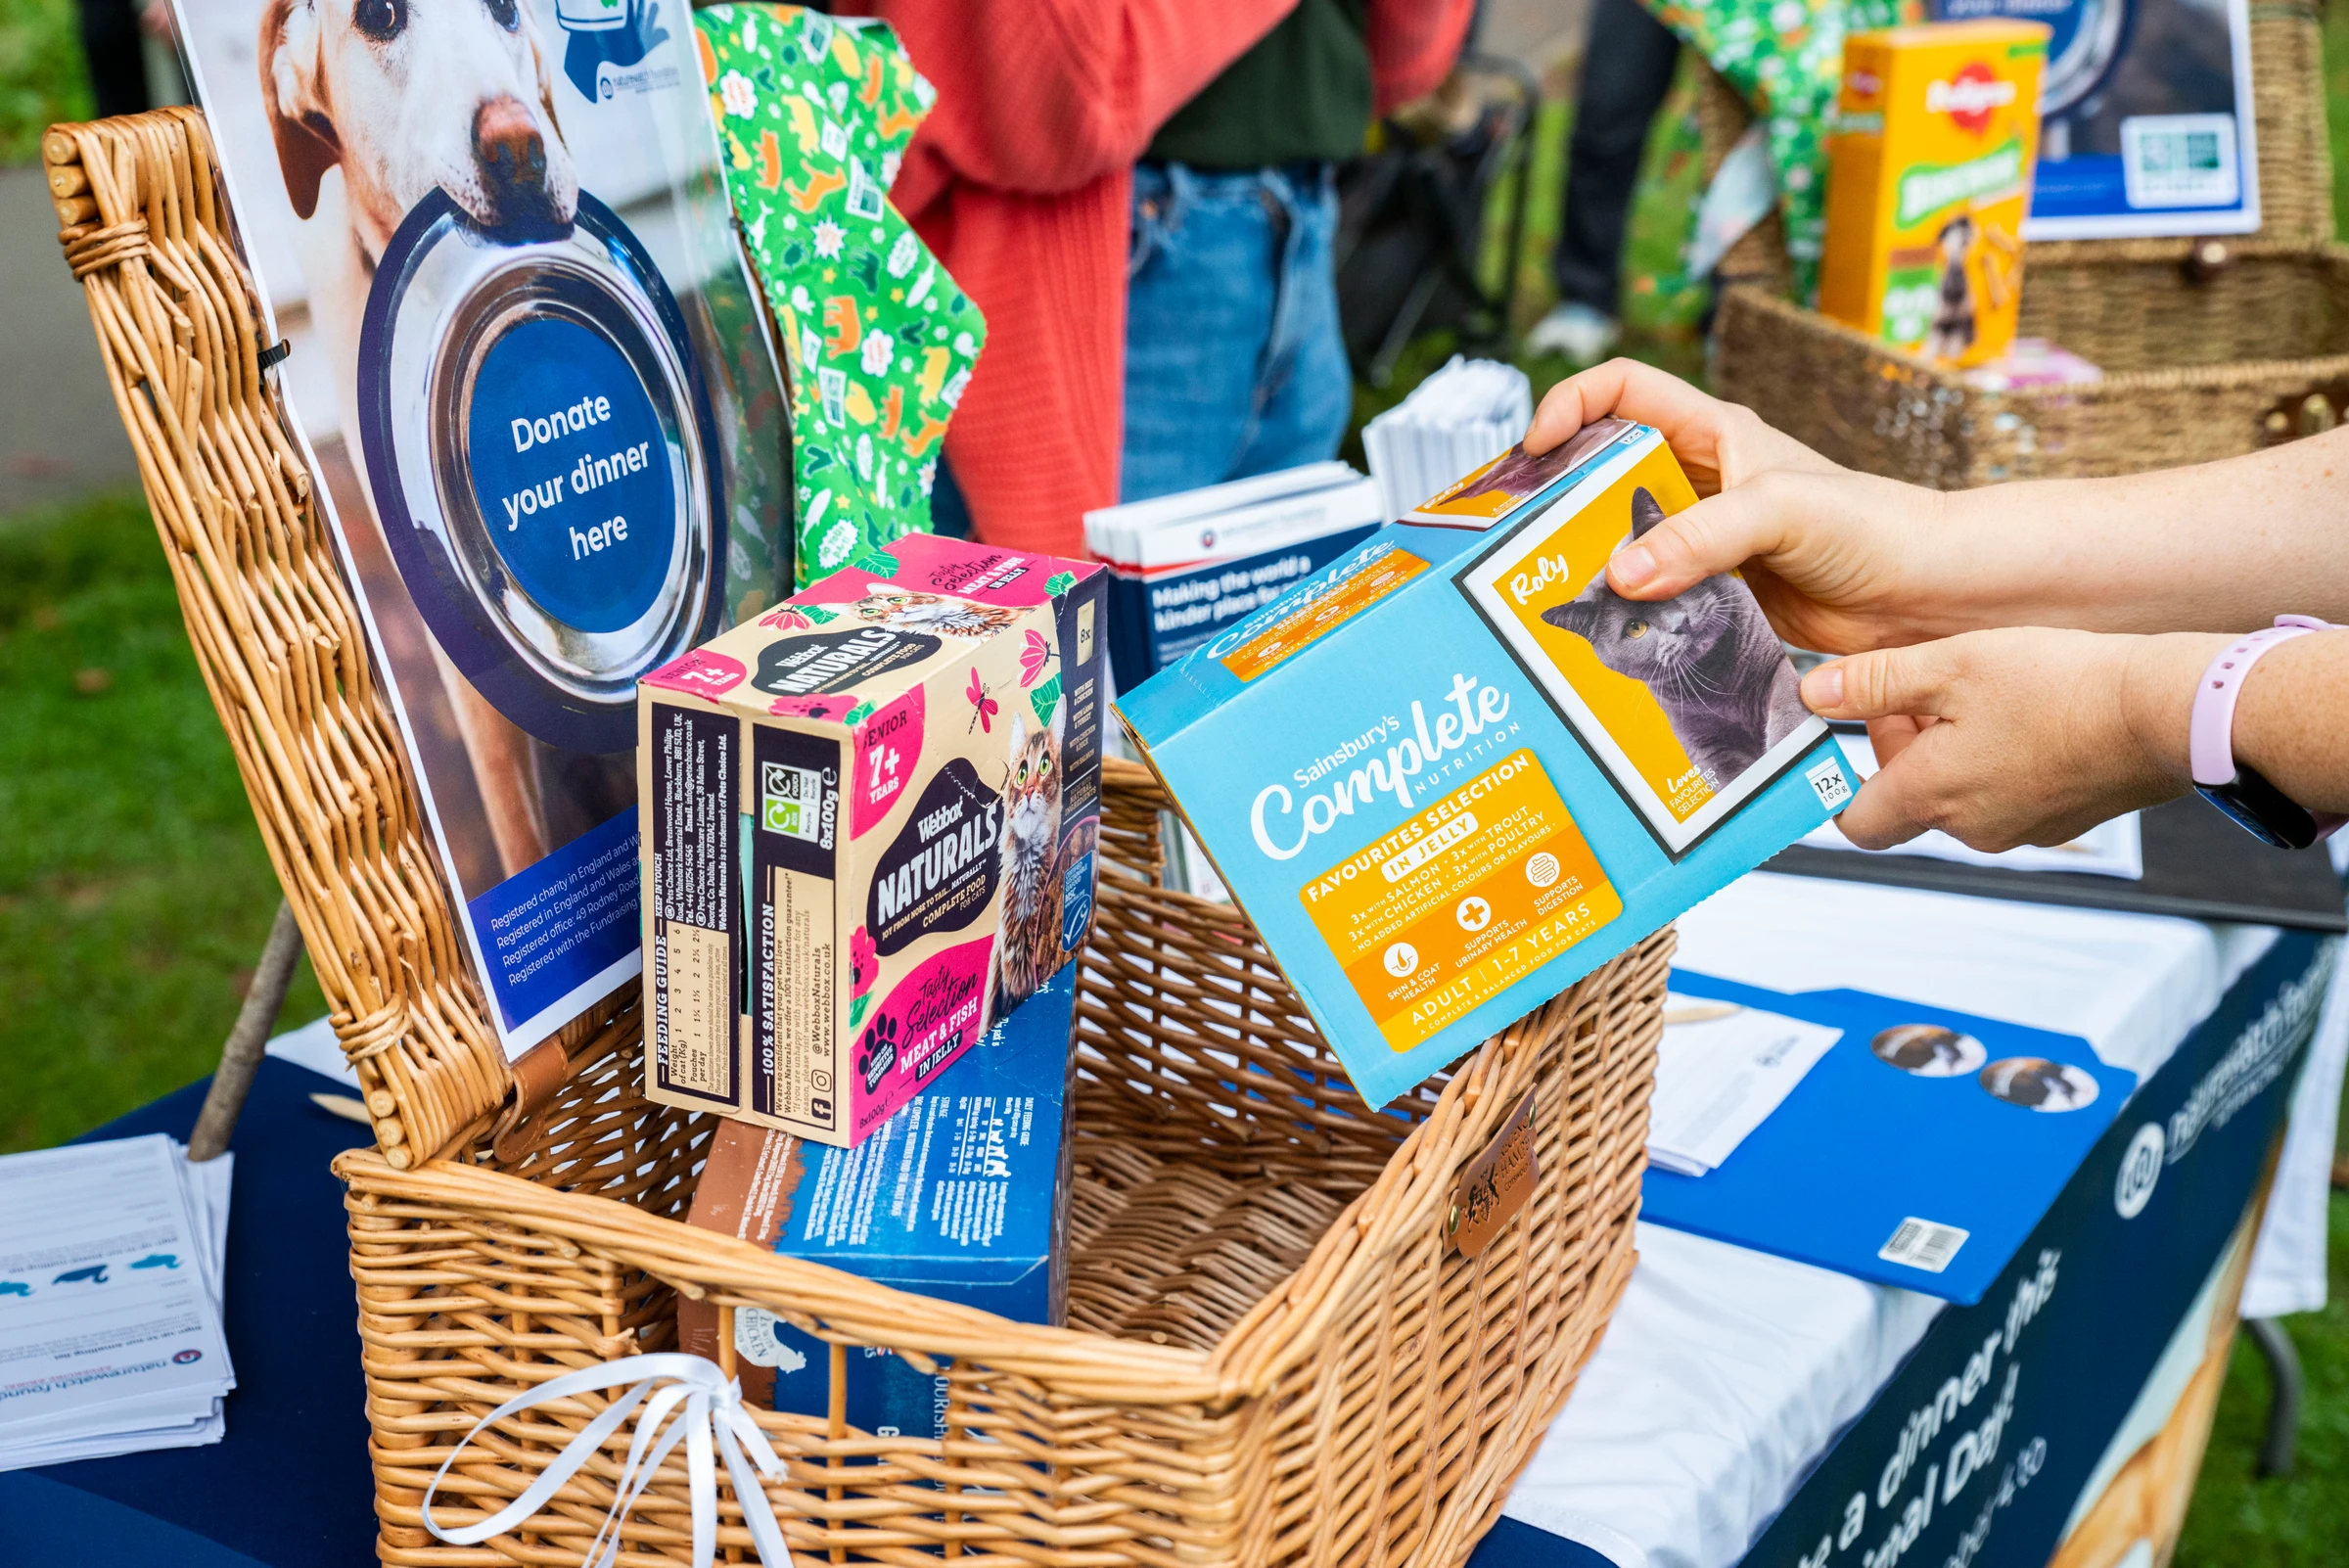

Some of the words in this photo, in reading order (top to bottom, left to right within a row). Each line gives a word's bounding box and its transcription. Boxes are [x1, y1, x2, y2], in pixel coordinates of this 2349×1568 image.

[510, 395, 611, 453] Donate
[501, 475, 564, 531] your
[570, 440, 649, 495] dinner
[568, 515, 628, 561] here
[1152, 577, 1221, 609] Making
[1221, 569, 1250, 593] the
[1251, 558, 1298, 585] world
[1298, 556, 1312, 574] a
[1206, 540, 1396, 660] Complete
[1509, 552, 1570, 607] Roly
[1154, 604, 1212, 634] kinder
[1214, 591, 1257, 623] place
[1244, 579, 1321, 630] Sainsbury's
[775, 643, 829, 668] Webbox
[1081, 627, 1091, 644] 8x
[767, 628, 897, 694] NATURALS
[869, 744, 900, 789] 7+
[1251, 673, 1510, 861] Complete
[1294, 713, 1402, 789] Sainsbury's
[1414, 720, 1521, 795] NUTRITION
[869, 775, 900, 805] YEARS
[1666, 763, 1701, 795] Loves
[1669, 767, 1717, 809] FAVOURITES
[1678, 777, 1721, 816] SELECTION
[1815, 773, 1843, 795] 12x
[1822, 785, 1848, 803] 100g
[819, 789, 840, 851] 8x100g
[918, 800, 963, 844] Webbox
[1307, 821, 1423, 902] FAVOURITES
[1425, 754, 1529, 828] SELECTION
[654, 852, 663, 884] TOUCH
[878, 803, 997, 927] NATURALS
[1351, 912, 1367, 925] 3x
[1366, 898, 1386, 912] WITH
[1386, 863, 1441, 902] SALMON
[1451, 848, 1467, 861] 3x
[1466, 836, 1486, 850] WITH
[1486, 806, 1529, 840] TROUT
[1388, 857, 1412, 879] IN
[1416, 817, 1473, 861] JELLY
[490, 893, 538, 932] Registered
[538, 877, 568, 902] charity
[567, 872, 578, 884] in
[576, 849, 613, 879] England
[613, 839, 629, 857] and
[654, 883, 663, 895] IN
[959, 896, 971, 910] FOR
[971, 885, 986, 901] CATS
[1348, 928, 1364, 942] 3x
[1364, 915, 1385, 930] WITH
[1385, 877, 1443, 919] CHICKEN
[1452, 862, 1469, 876] 3x
[1468, 850, 1488, 863] WITH
[1488, 810, 1544, 853] POULTRY
[1357, 939, 1371, 951] NO
[1373, 919, 1403, 942] ADDED
[1405, 890, 1451, 922] ARTIFICIAL
[1451, 861, 1493, 892] COLOURS
[1493, 853, 1506, 865] OR
[1506, 824, 1551, 856] FLAVOURS
[1533, 875, 1578, 907] SUPPORTS
[495, 911, 544, 949] Registered
[542, 908, 554, 921] in
[552, 883, 589, 914] England
[589, 873, 606, 893] and
[605, 860, 631, 881] Wales
[654, 894, 663, 918] KEEP
[881, 925, 893, 941] JOY
[893, 912, 910, 932] FROM
[910, 901, 926, 920] NOSE
[925, 896, 935, 908] TO
[922, 889, 965, 928] COMPLETE
[965, 874, 986, 897] FOOD
[1537, 882, 1584, 916] DIGESTION
[501, 929, 550, 968] Registered
[550, 916, 576, 940] office:
[576, 908, 587, 922] 49
[587, 887, 619, 918] Rodney
[507, 947, 555, 987] Registered
[554, 937, 576, 956] with
[574, 928, 590, 944] the
[589, 898, 638, 934] Fundraising
[1454, 939, 1493, 968] URINARY
[1493, 918, 1528, 944] HEALTH
[1464, 919, 1509, 951] SUPPORTS
[655, 935, 669, 990] GUIDE
[762, 903, 775, 1032] SATISFACTION
[776, 976, 785, 992] pet
[919, 963, 951, 1004] Tasty
[1387, 983, 1409, 1000] SKIN
[1408, 978, 1417, 987] &
[1416, 962, 1440, 982] COAT
[1412, 976, 1471, 1026] ADULT
[1492, 945, 1519, 972] 1-7
[1526, 901, 1590, 948] YEARS
[1428, 998, 1472, 1030] COMPLETE
[1482, 964, 1527, 995] BALANCED
[1529, 946, 1552, 965] FOOD
[1554, 935, 1573, 948] FOR
[1574, 919, 1595, 936] CATS
[776, 991, 785, 1012] your
[812, 947, 824, 1055] @WebboxNaturals
[823, 944, 832, 1057] www.webbox.co.uk
[902, 971, 979, 1049] Selection
[1402, 976, 1436, 1002] HEALTH
[655, 991, 670, 1067] FEEDING
[774, 1012, 783, 1030] that
[900, 1036, 937, 1075] MEAT
[940, 1026, 947, 1043] &
[949, 995, 979, 1034] FISH
[670, 1044, 680, 1077] Weight
[677, 1039, 688, 1059] (Kg)
[689, 1048, 698, 1083] Pouches
[697, 1050, 707, 1067] day
[762, 1034, 774, 1077] 100%
[774, 1030, 783, 1071] confident
[918, 1060, 930, 1079] IN
[932, 1034, 959, 1069] JELLY
[678, 1074, 686, 1086] of
[699, 1067, 708, 1083] per
[774, 1072, 783, 1083] so
[774, 1082, 783, 1097] are
[774, 1097, 783, 1111] We
[746, 1308, 768, 1359] CHICKEN
[1838, 1492, 1867, 1552] a
[1877, 1328, 2003, 1509] dinner
